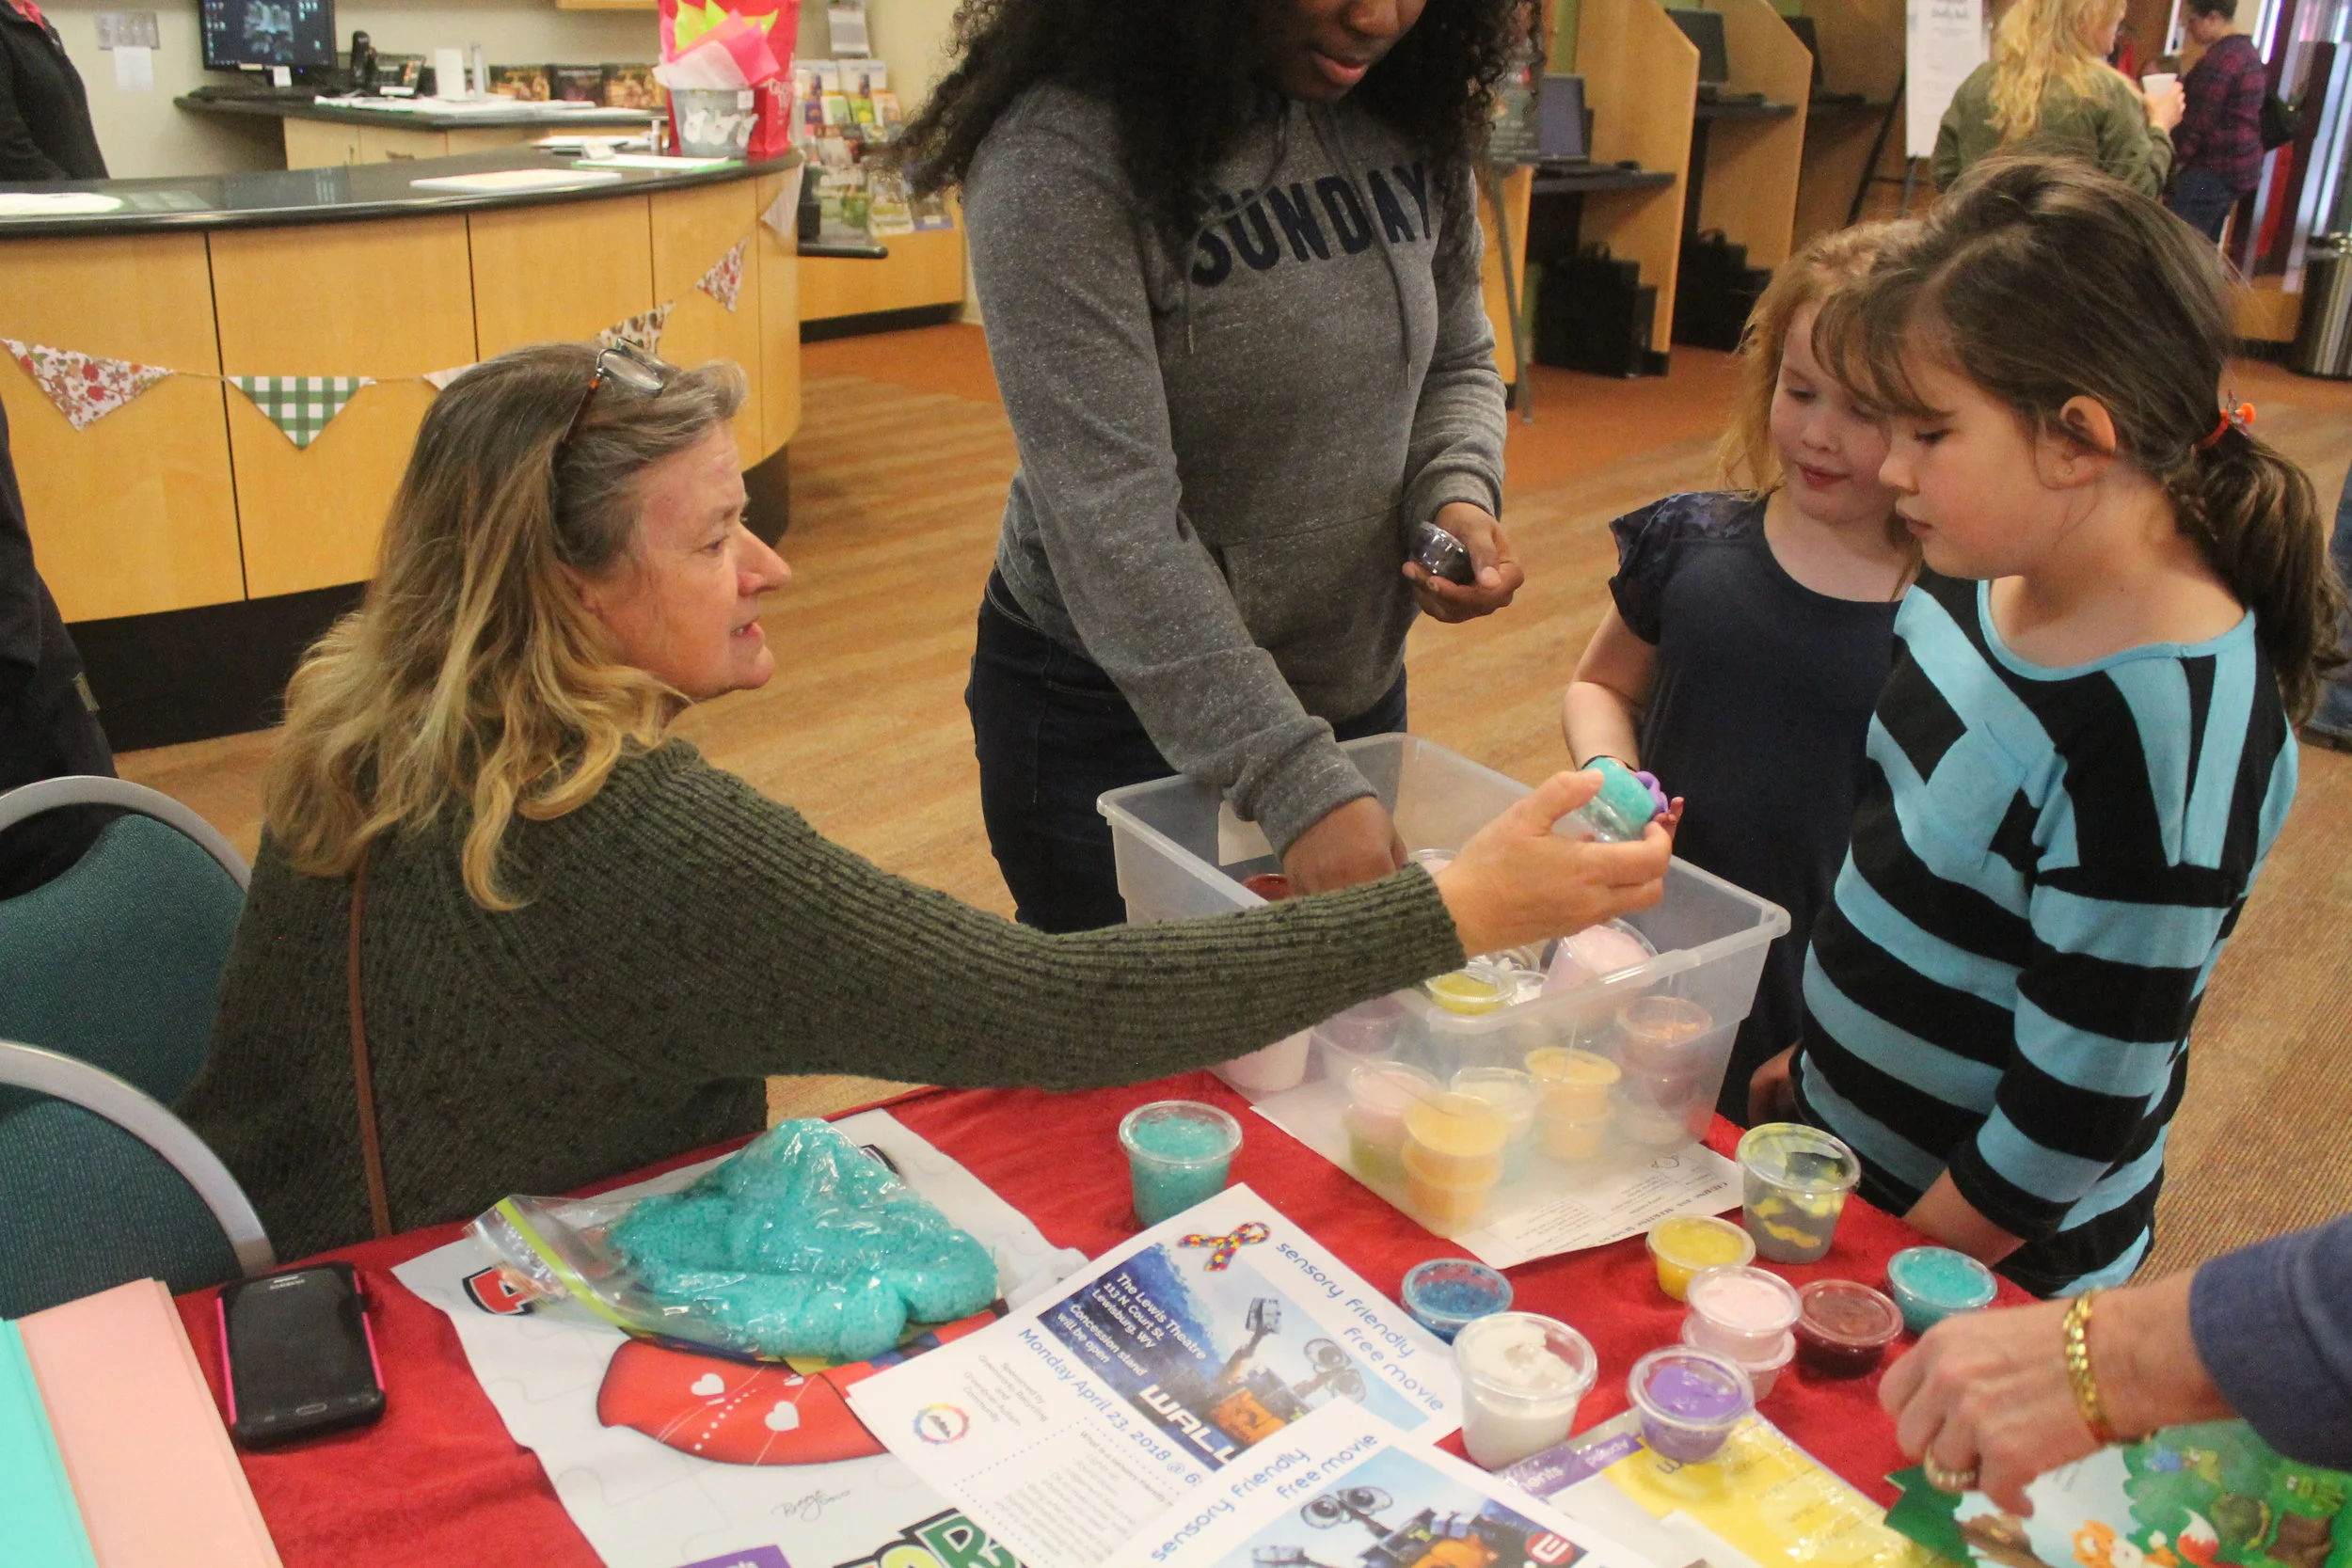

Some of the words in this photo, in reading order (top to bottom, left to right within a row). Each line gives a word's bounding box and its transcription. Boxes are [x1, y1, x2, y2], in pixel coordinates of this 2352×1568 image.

[1191, 164, 1431, 287] SUNDAY
[1057, 1313, 1075, 1334] will
[1073, 1326, 1088, 1343] be
[1084, 1338, 1110, 1363] open
[1070, 1304, 1120, 1354] Concession
[1116, 1349, 1149, 1377] stand
[1103, 1282, 1120, 1299] 113
[1128, 1304, 1152, 1332] Court
[1116, 1273, 1137, 1294] The
[1136, 1290, 1168, 1323] Lewis
[1166, 1319, 1206, 1360] Theatre
[1136, 1331, 1156, 1349] WV
[1276, 1243, 1344, 1299] sensory
[1344, 1298, 1416, 1358] friendly
[1018, 1328, 1074, 1382] Monday
[1072, 1380, 1113, 1411] April
[1130, 1430, 1171, 1462] 2018
[1343, 1327, 1385, 1362] free
[1383, 1363, 1444, 1411] movie
[1152, 1498, 1236, 1561] sensory
[1231, 1448, 1311, 1497] friendly
[1277, 1471, 1322, 1499] free
[1321, 1433, 1377, 1474] movie
